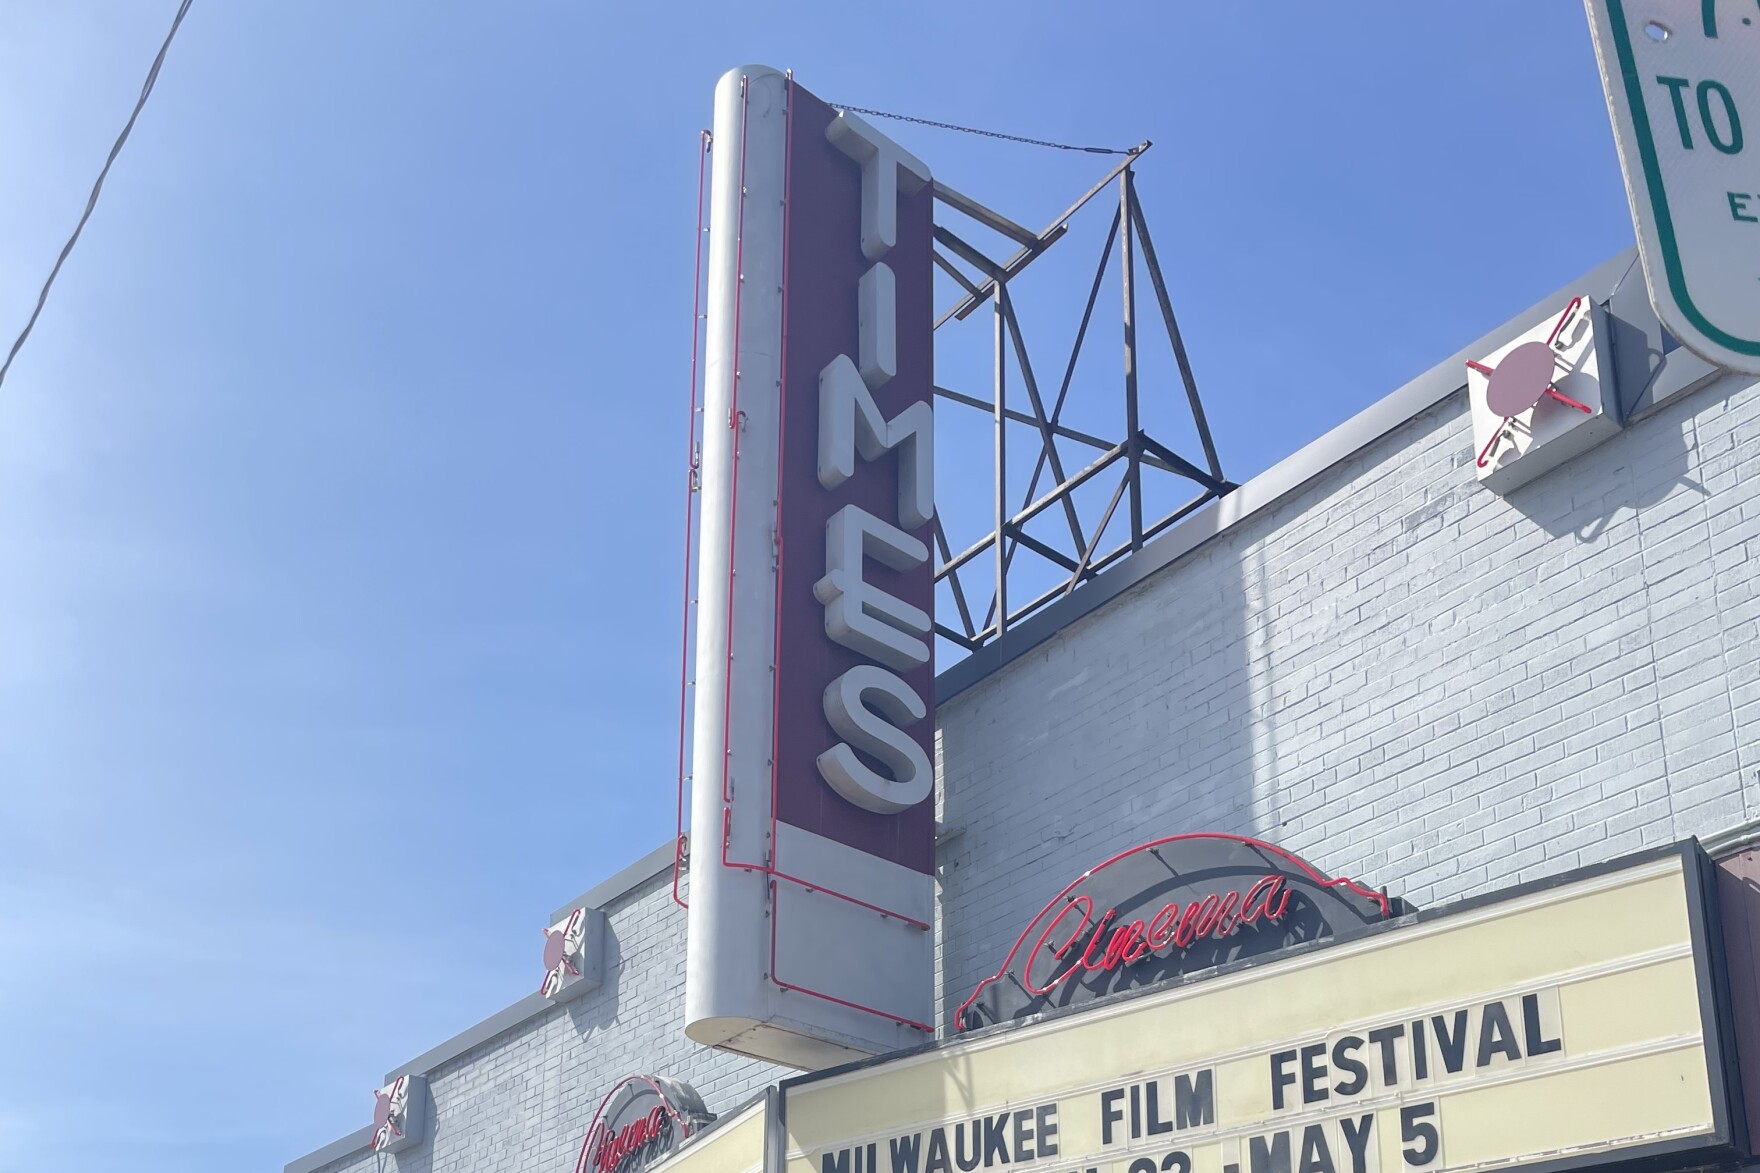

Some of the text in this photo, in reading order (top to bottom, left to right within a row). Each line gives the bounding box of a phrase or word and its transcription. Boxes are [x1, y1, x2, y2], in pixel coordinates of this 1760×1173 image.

[1656, 75, 1744, 155] TO
[814, 109, 933, 815] TIMES
[1024, 875, 1292, 995] Cinema
[1101, 1069, 1214, 1145] FILM
[1271, 993, 1562, 1110] FESTIVAL
[1400, 1101, 1439, 1167] 5
